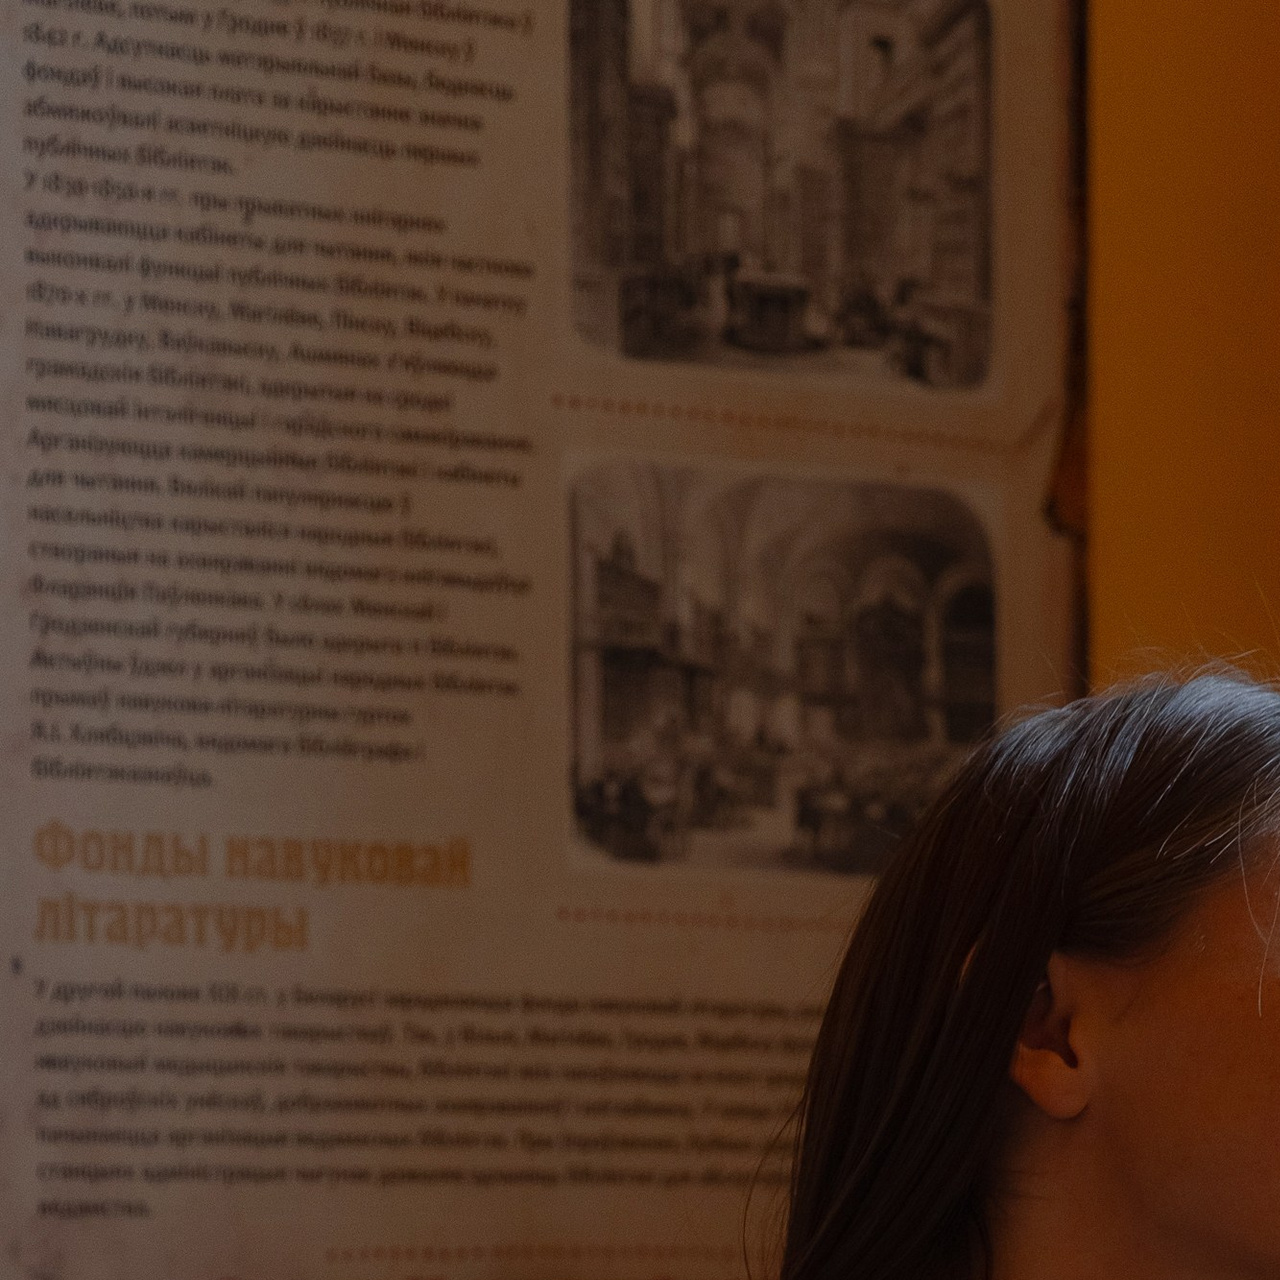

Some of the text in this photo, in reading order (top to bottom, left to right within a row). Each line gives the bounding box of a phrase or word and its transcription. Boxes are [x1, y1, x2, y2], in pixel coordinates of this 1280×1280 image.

[34, 821, 471, 889] Фонды навуковай
[34, 893, 308, 952] літаратуры
